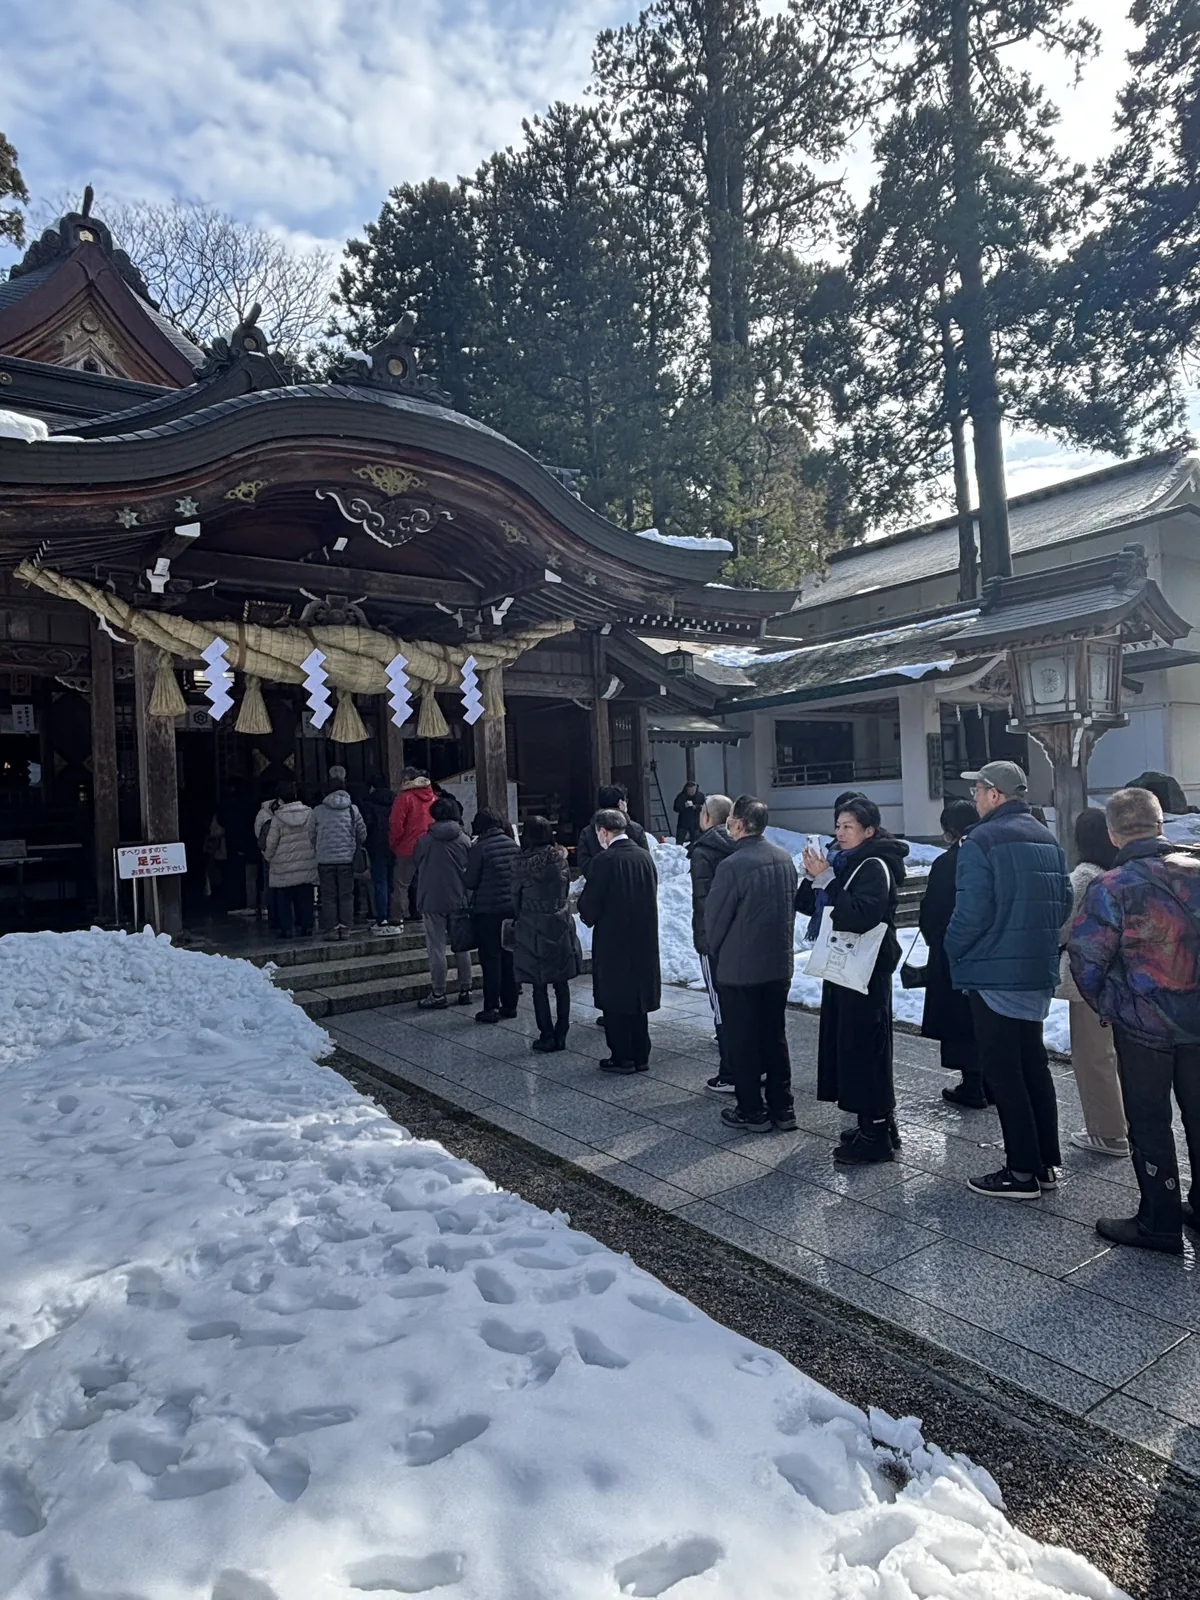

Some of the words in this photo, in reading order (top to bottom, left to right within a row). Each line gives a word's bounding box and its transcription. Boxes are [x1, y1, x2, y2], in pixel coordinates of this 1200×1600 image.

[138, 855, 169, 866] 足元に
[131, 865, 186, 876] お気をつけ下さい
